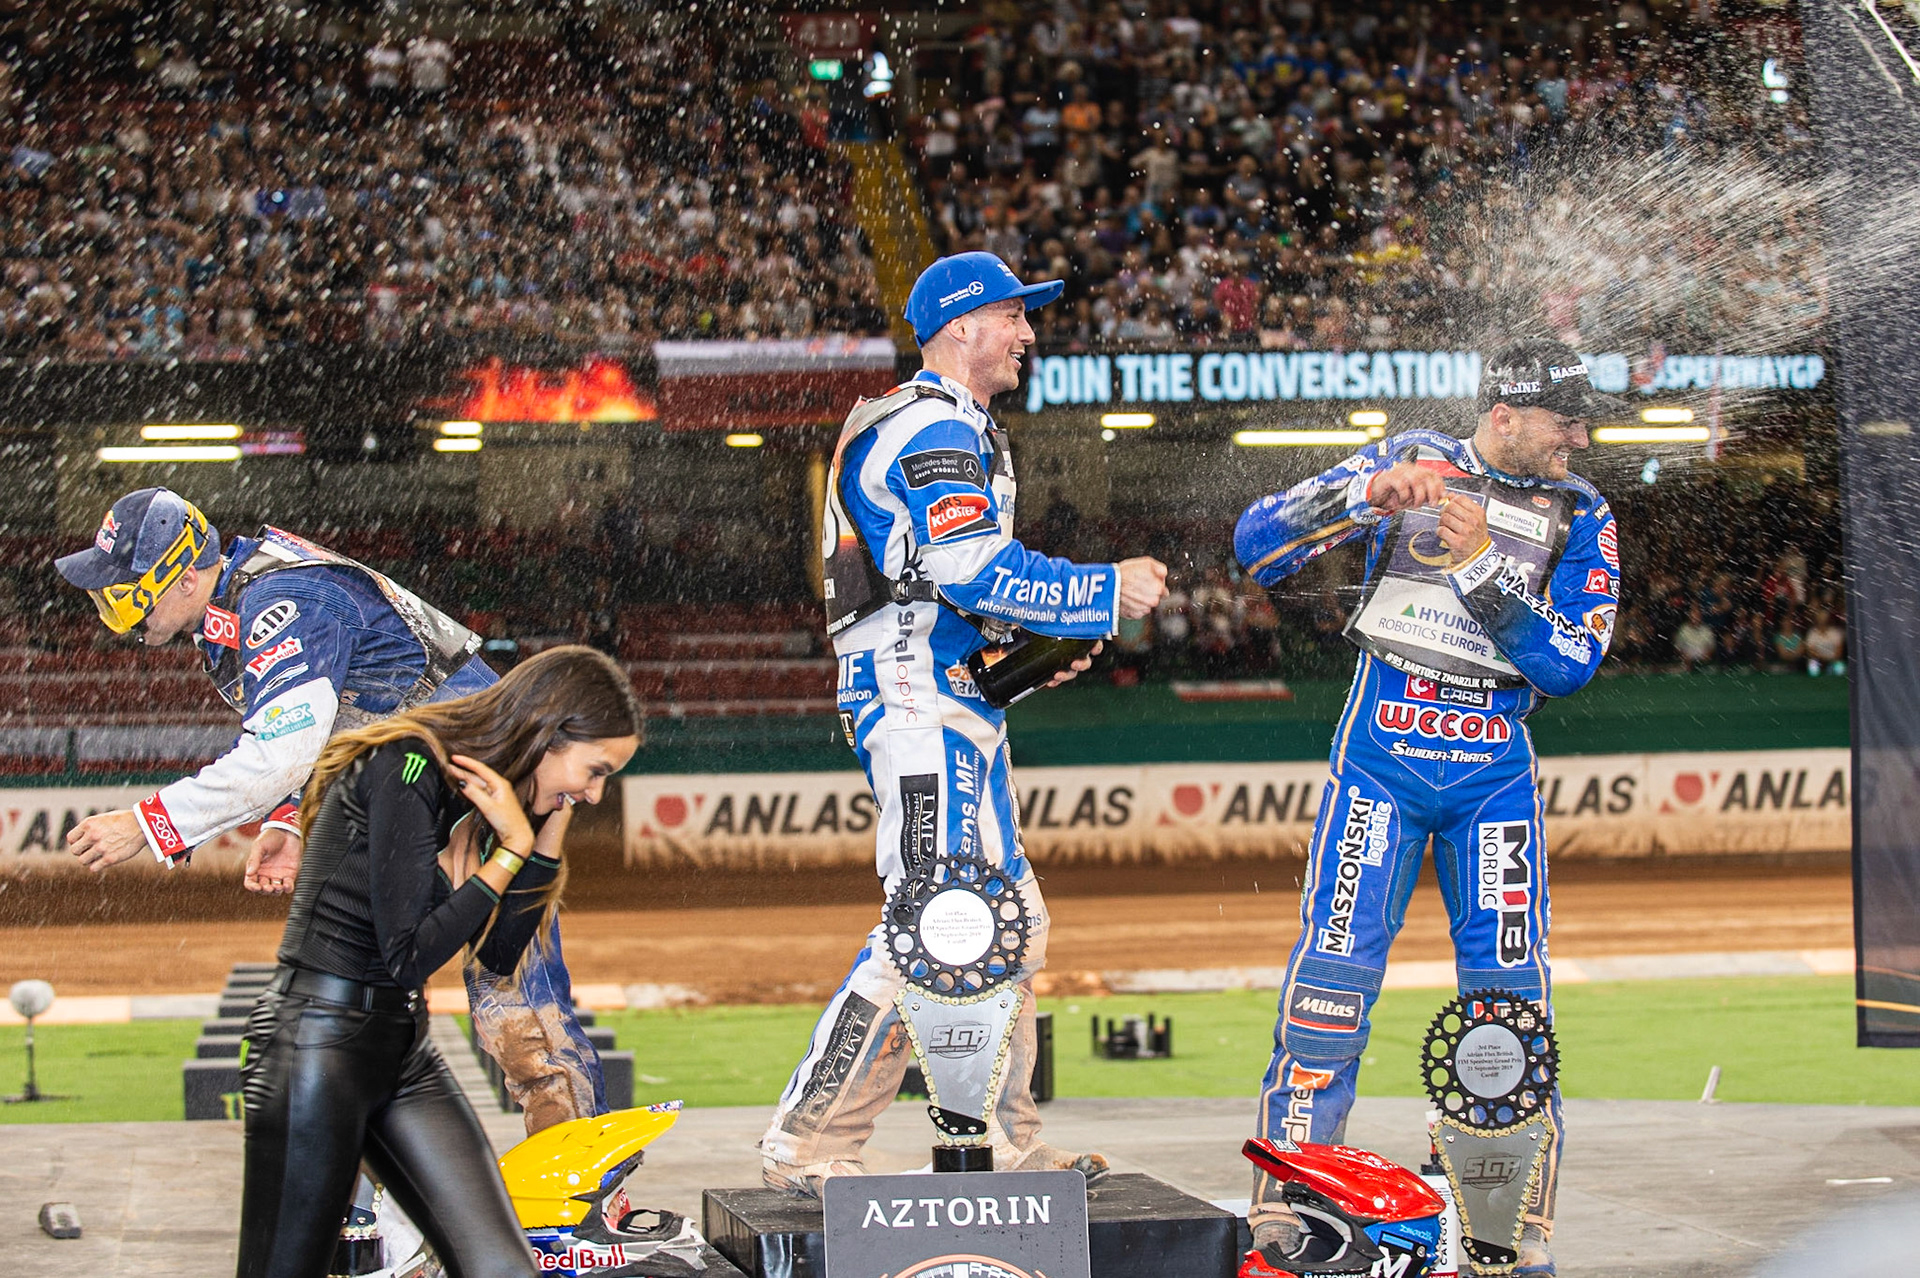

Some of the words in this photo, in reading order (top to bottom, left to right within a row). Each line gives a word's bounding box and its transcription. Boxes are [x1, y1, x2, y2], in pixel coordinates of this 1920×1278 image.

[1027, 354, 1109, 412] JOIN
[1116, 353, 1194, 402] THE
[1200, 350, 1480, 401] CONVERSATION
[911, 457, 959, 472] Mercedes-Benz
[931, 505, 978, 529] KLOSTER
[1505, 512, 1536, 528] HYUNDAI
[991, 566, 1063, 606] Trans
[1067, 573, 1107, 607] MF
[976, 598, 1056, 624] Internationale
[1060, 609, 1110, 627] Spedition
[1419, 605, 1492, 642] HYUNDA
[1379, 617, 1437, 641] ROBOTICS
[1441, 632, 1488, 658] EUROPE
[1384, 652, 1404, 672] #95
[1403, 658, 1442, 681] BARTOSZ
[1441, 672, 1481, 689] ZMARZLIK
[1482, 680, 1498, 689] POL
[1440, 687, 1484, 704] CARS
[956, 750, 974, 795] MF
[1720, 770, 1849, 812] ANLA
[709, 784, 875, 834] ANLAS
[1018, 784, 1135, 829] NLAS
[1222, 782, 1316, 826] ANL
[1546, 776, 1637, 816] LAS
[959, 801, 977, 855] ans
[1366, 802, 1390, 863] logistic
[1325, 799, 1371, 953] MASZOŃSKI
[1483, 827, 1498, 906] NORDIC
[1295, 996, 1356, 1018] Mitas
[929, 1024, 992, 1048] SGP
[1462, 1156, 1522, 1179] SGP
[862, 1195, 1051, 1228] AZTORIN
[580, 1243, 626, 1269] Bull
